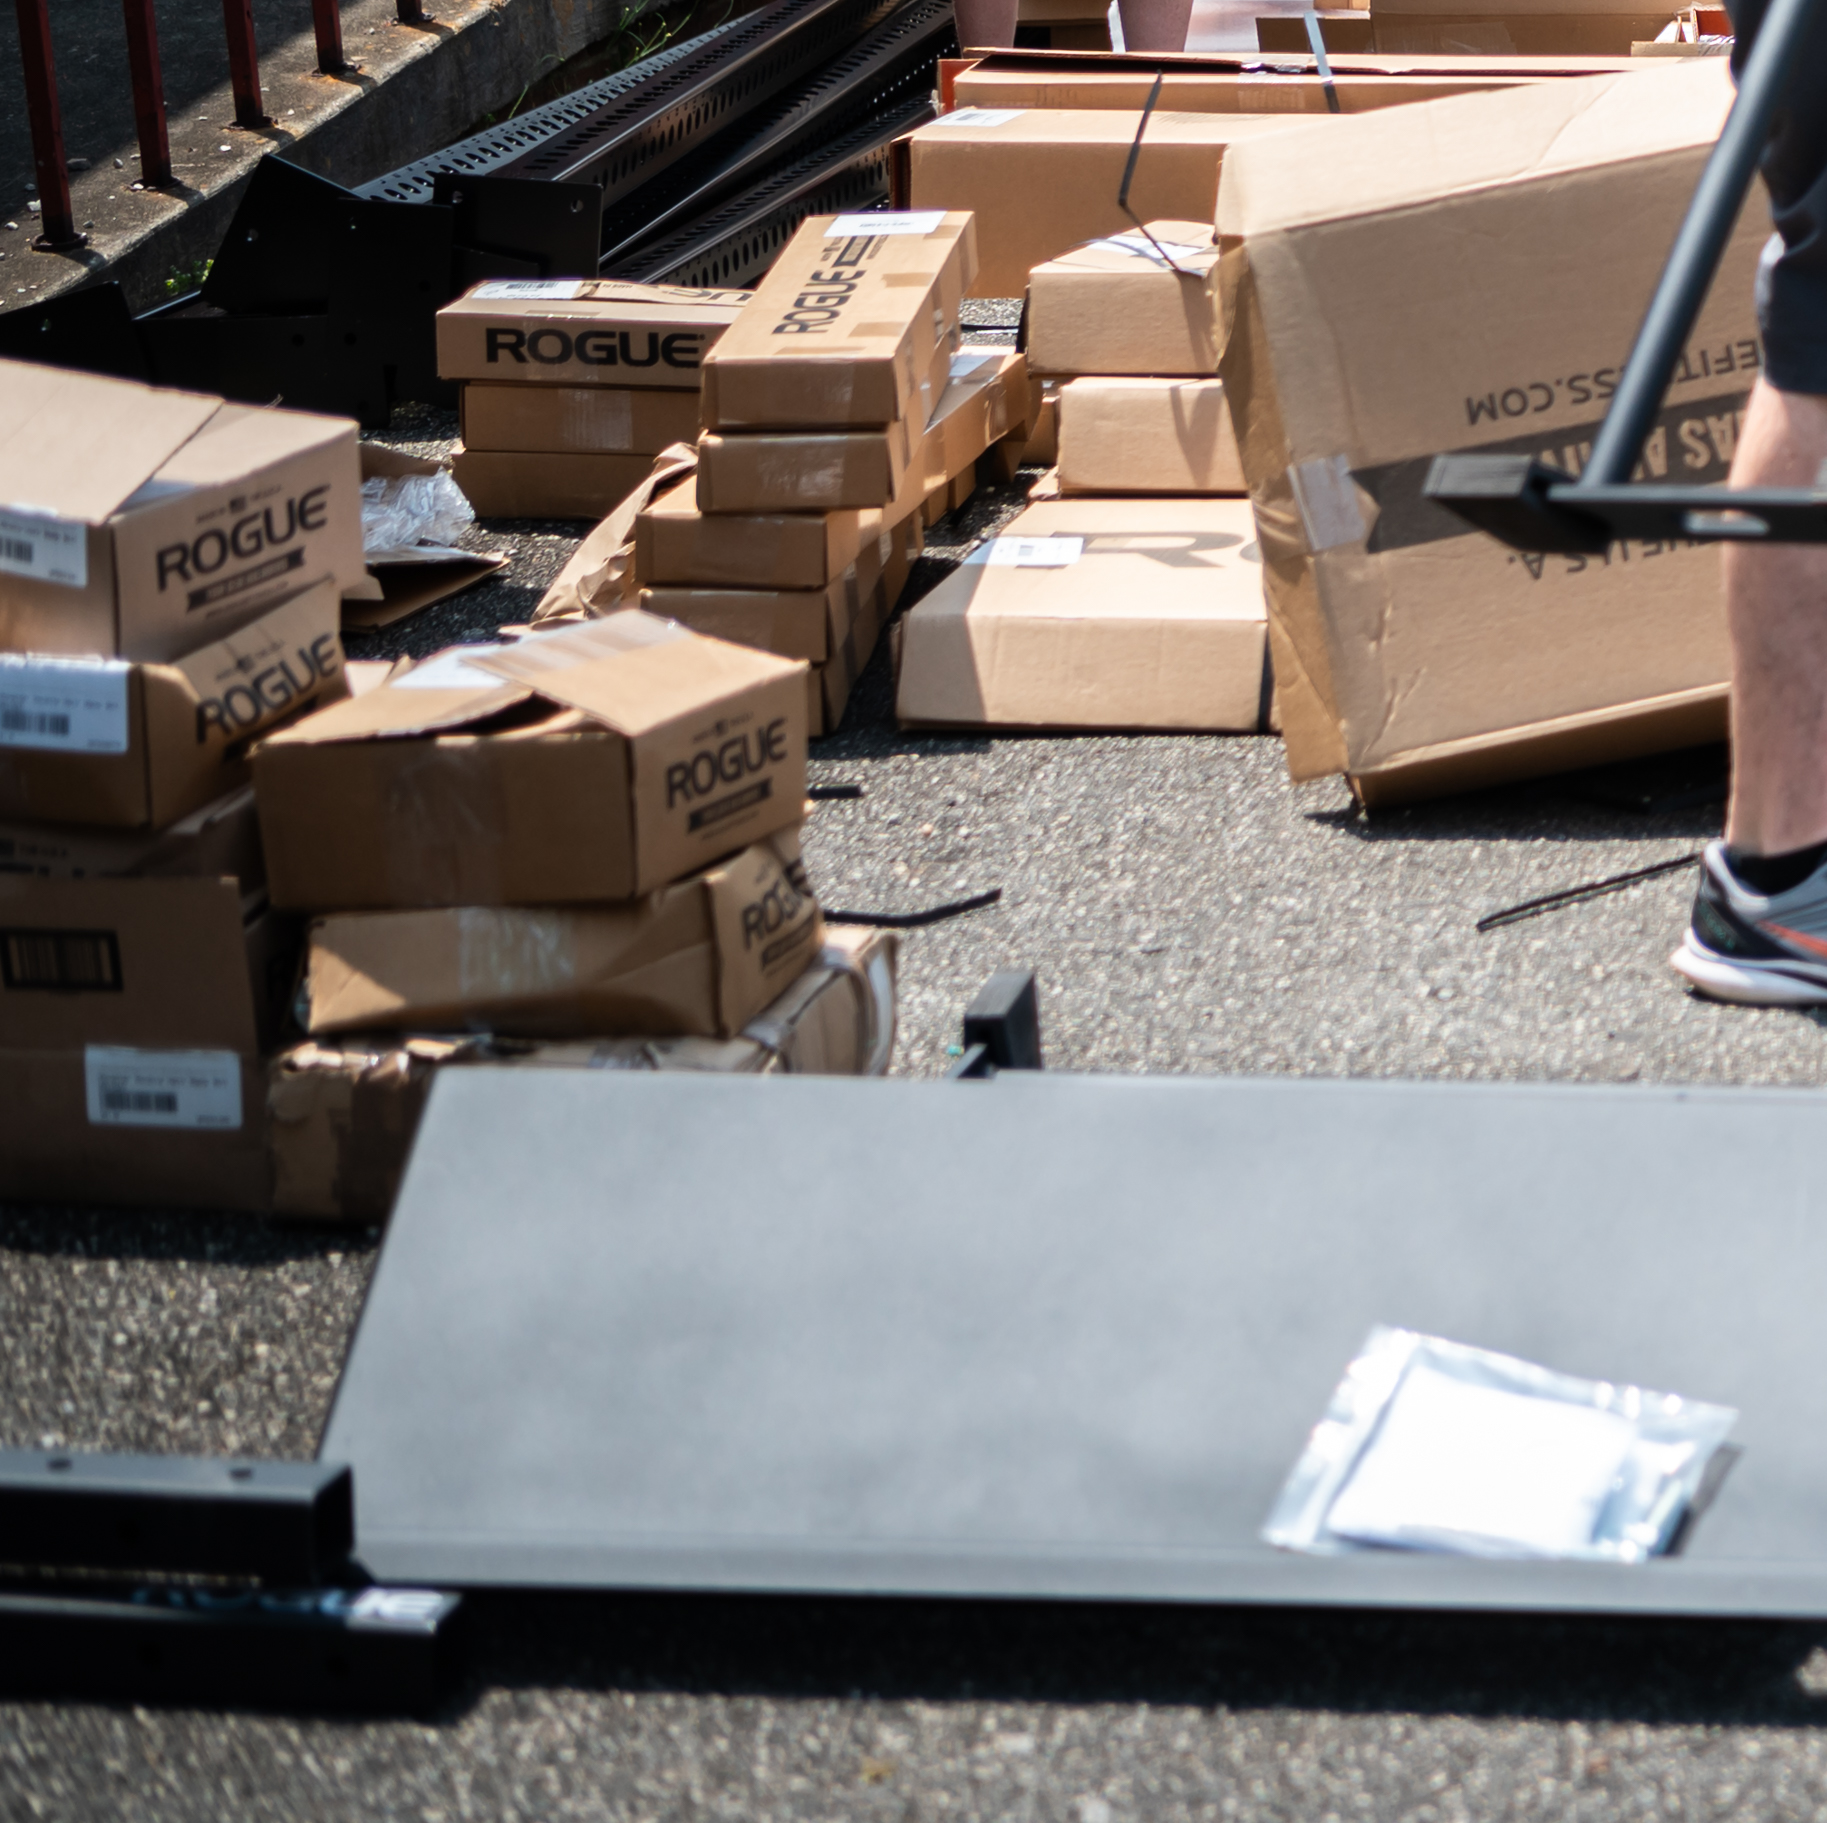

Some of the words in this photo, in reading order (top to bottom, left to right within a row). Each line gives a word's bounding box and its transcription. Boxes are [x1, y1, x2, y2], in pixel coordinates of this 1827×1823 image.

[486, 327, 701, 368] ROGUE
[771, 269, 868, 335] ROGUE
[155, 483, 332, 594] ROGUE
[196, 632, 339, 745] ROGUE
[666, 716, 788, 812] ROGUE
